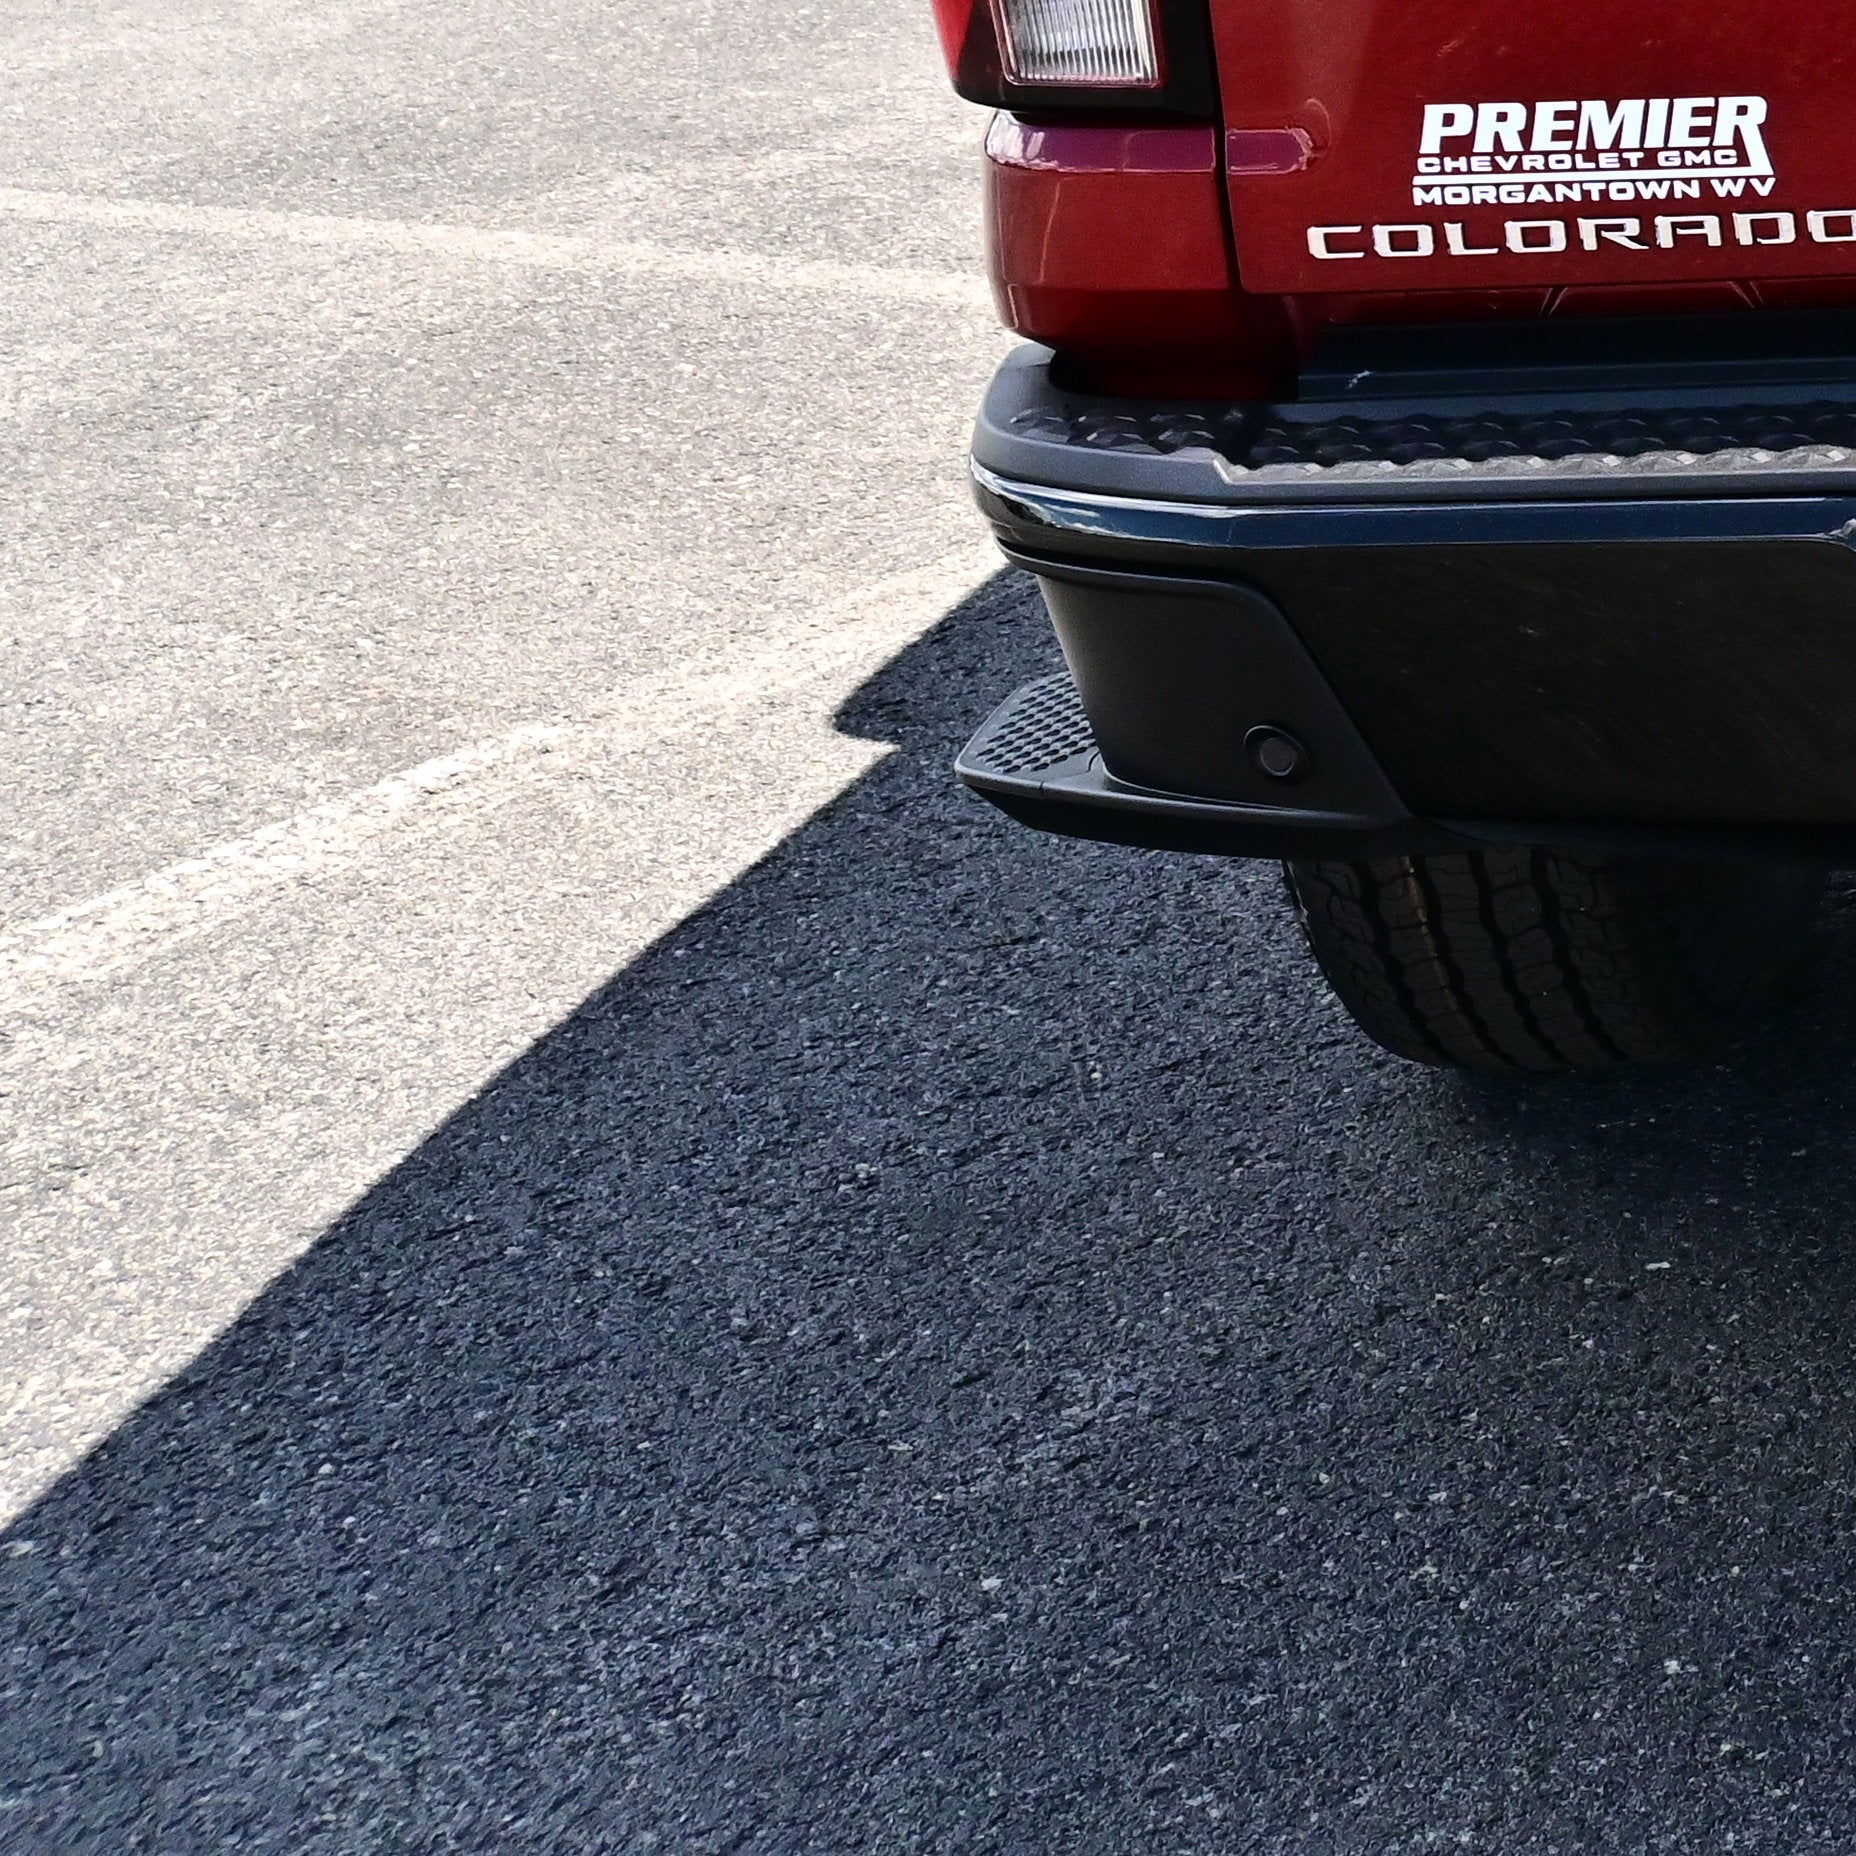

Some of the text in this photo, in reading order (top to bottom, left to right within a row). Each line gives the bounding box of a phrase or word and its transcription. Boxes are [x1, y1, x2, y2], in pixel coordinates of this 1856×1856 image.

[1418, 96, 1772, 162] PREMIER
[1417, 148, 1738, 174] CHEVROLET GMC
[1413, 177, 1776, 206] MORGANTOWN WV
